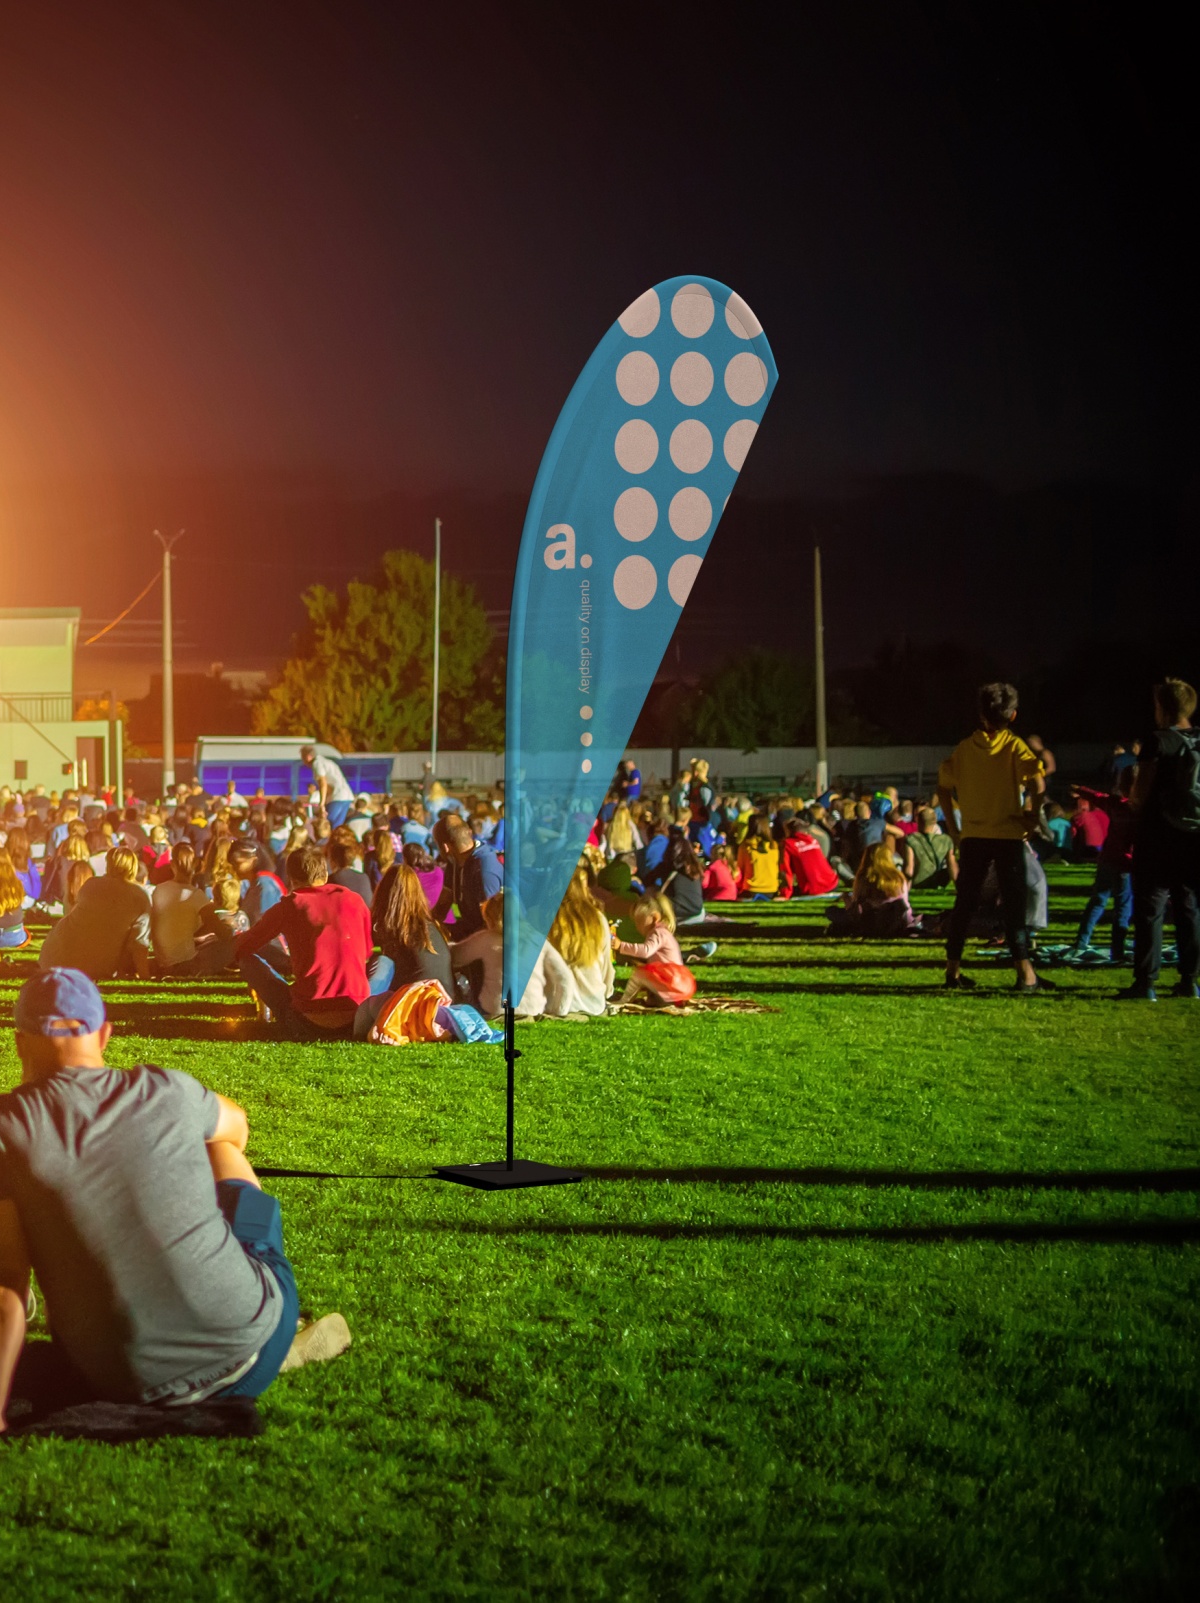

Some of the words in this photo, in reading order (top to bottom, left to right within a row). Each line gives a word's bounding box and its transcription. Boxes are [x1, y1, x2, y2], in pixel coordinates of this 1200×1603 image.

[543, 523, 593, 570] a.
[579, 579, 593, 624] quality
[581, 627, 591, 644] on
[578, 647, 593, 694] display
